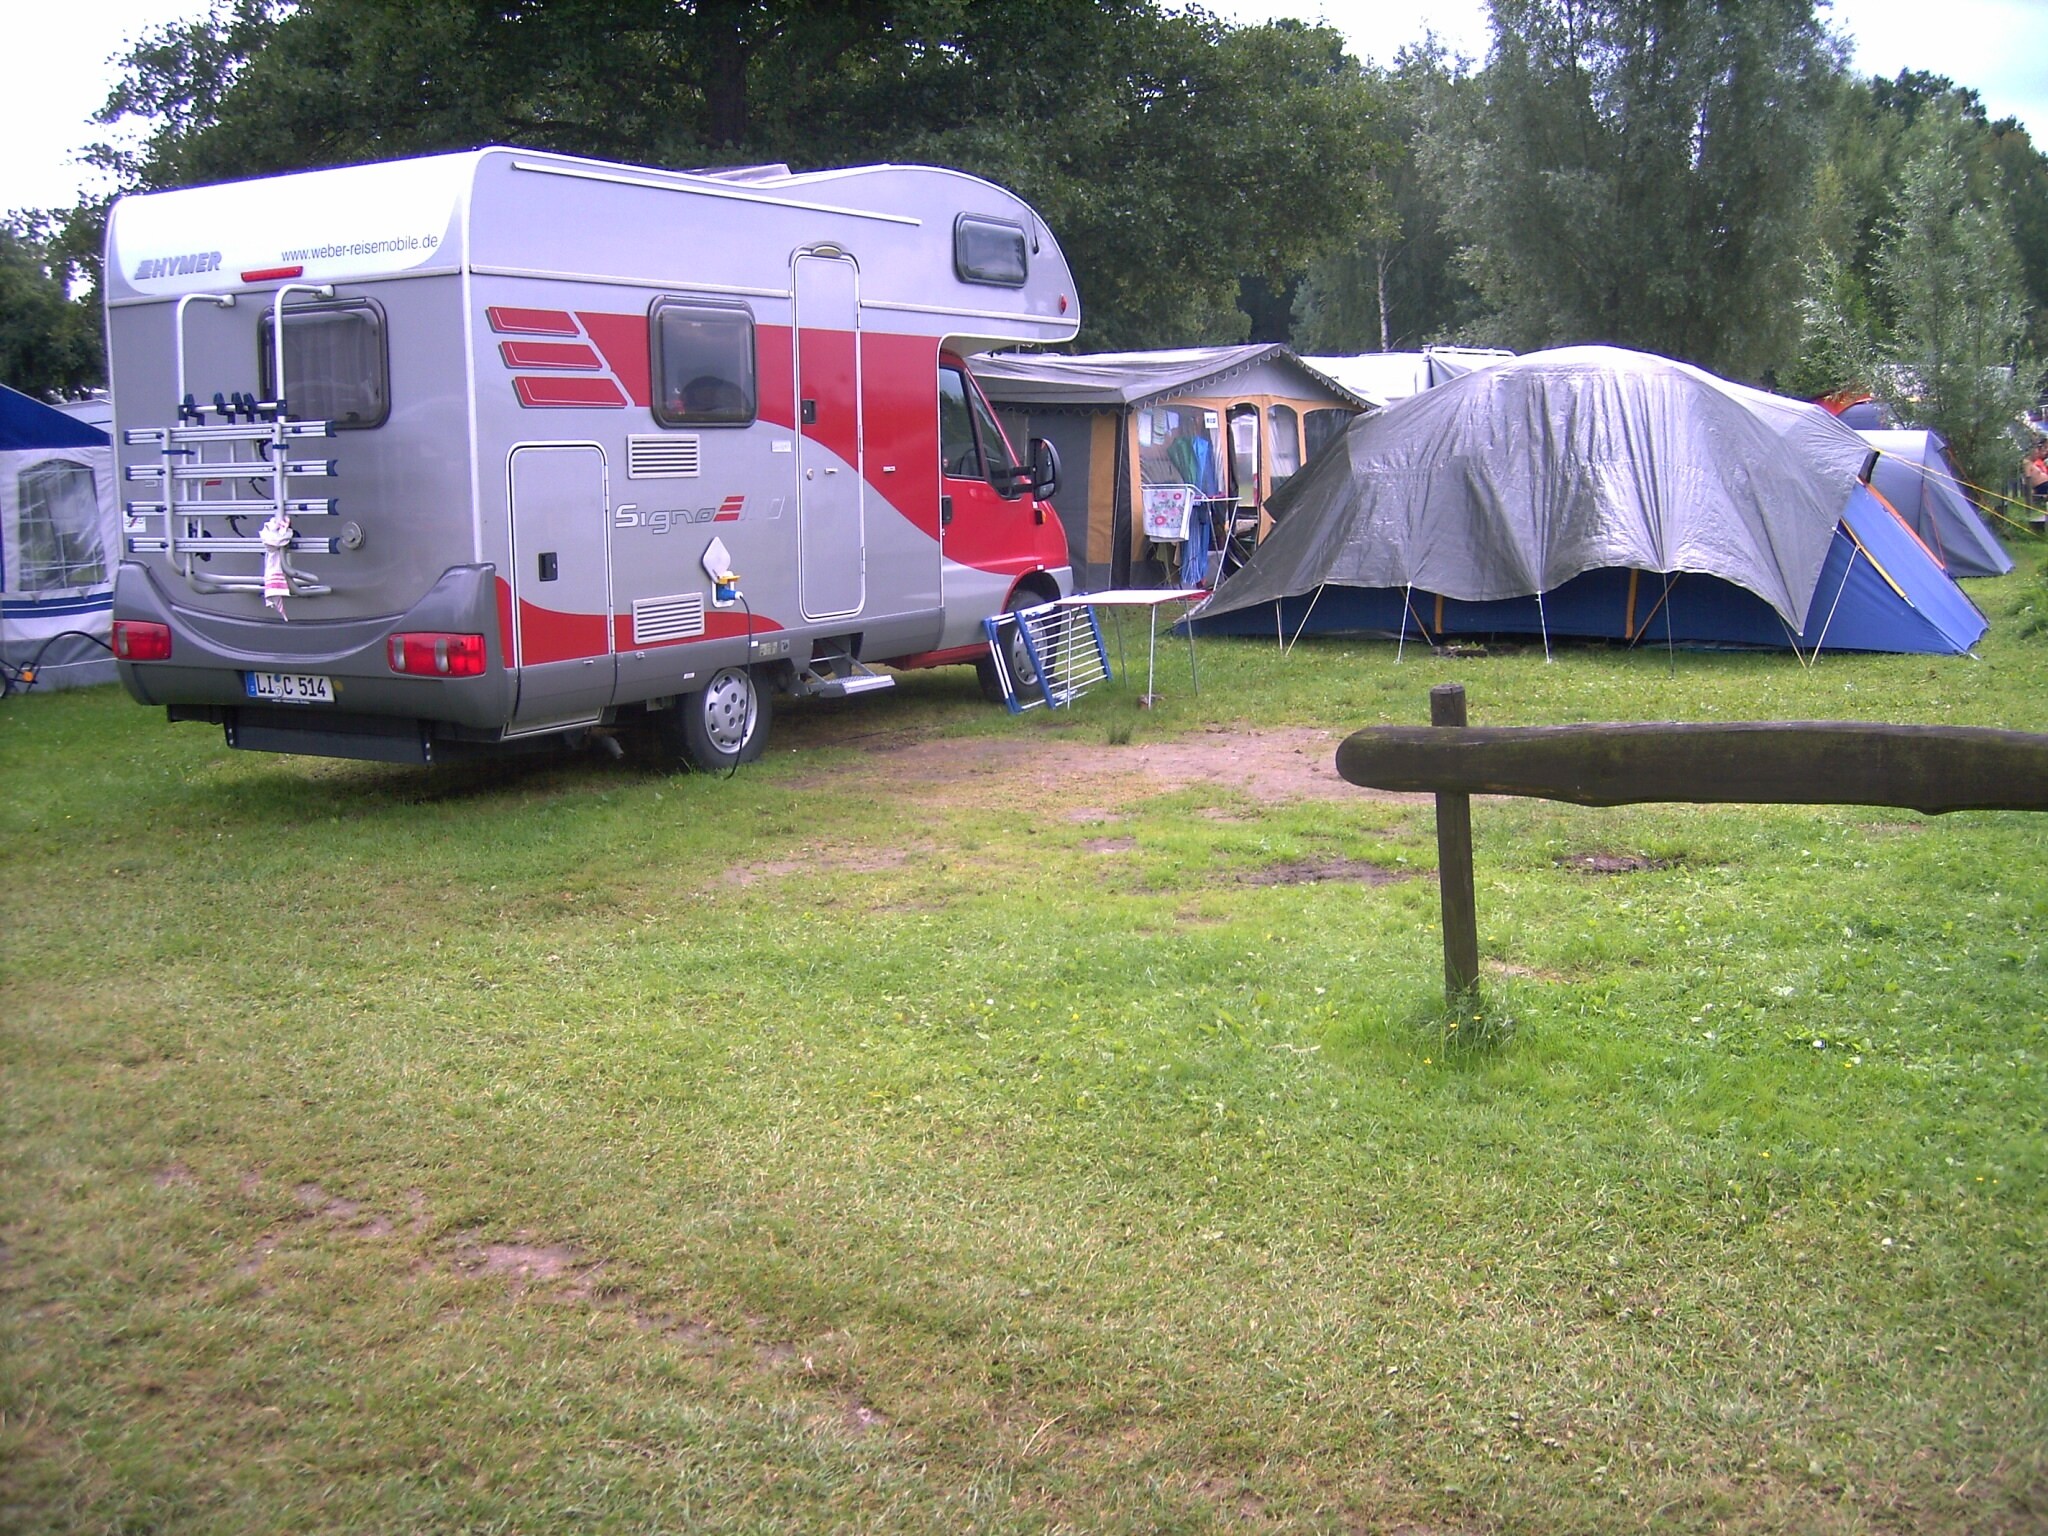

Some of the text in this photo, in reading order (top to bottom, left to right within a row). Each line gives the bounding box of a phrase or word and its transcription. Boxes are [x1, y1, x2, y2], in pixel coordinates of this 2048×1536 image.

[281, 234, 439, 262] www.weber-reisemobile.de
[151, 251, 222, 278] HYMER
[615, 503, 716, 535] Signo
[256, 674, 326, 697] LI C 514
